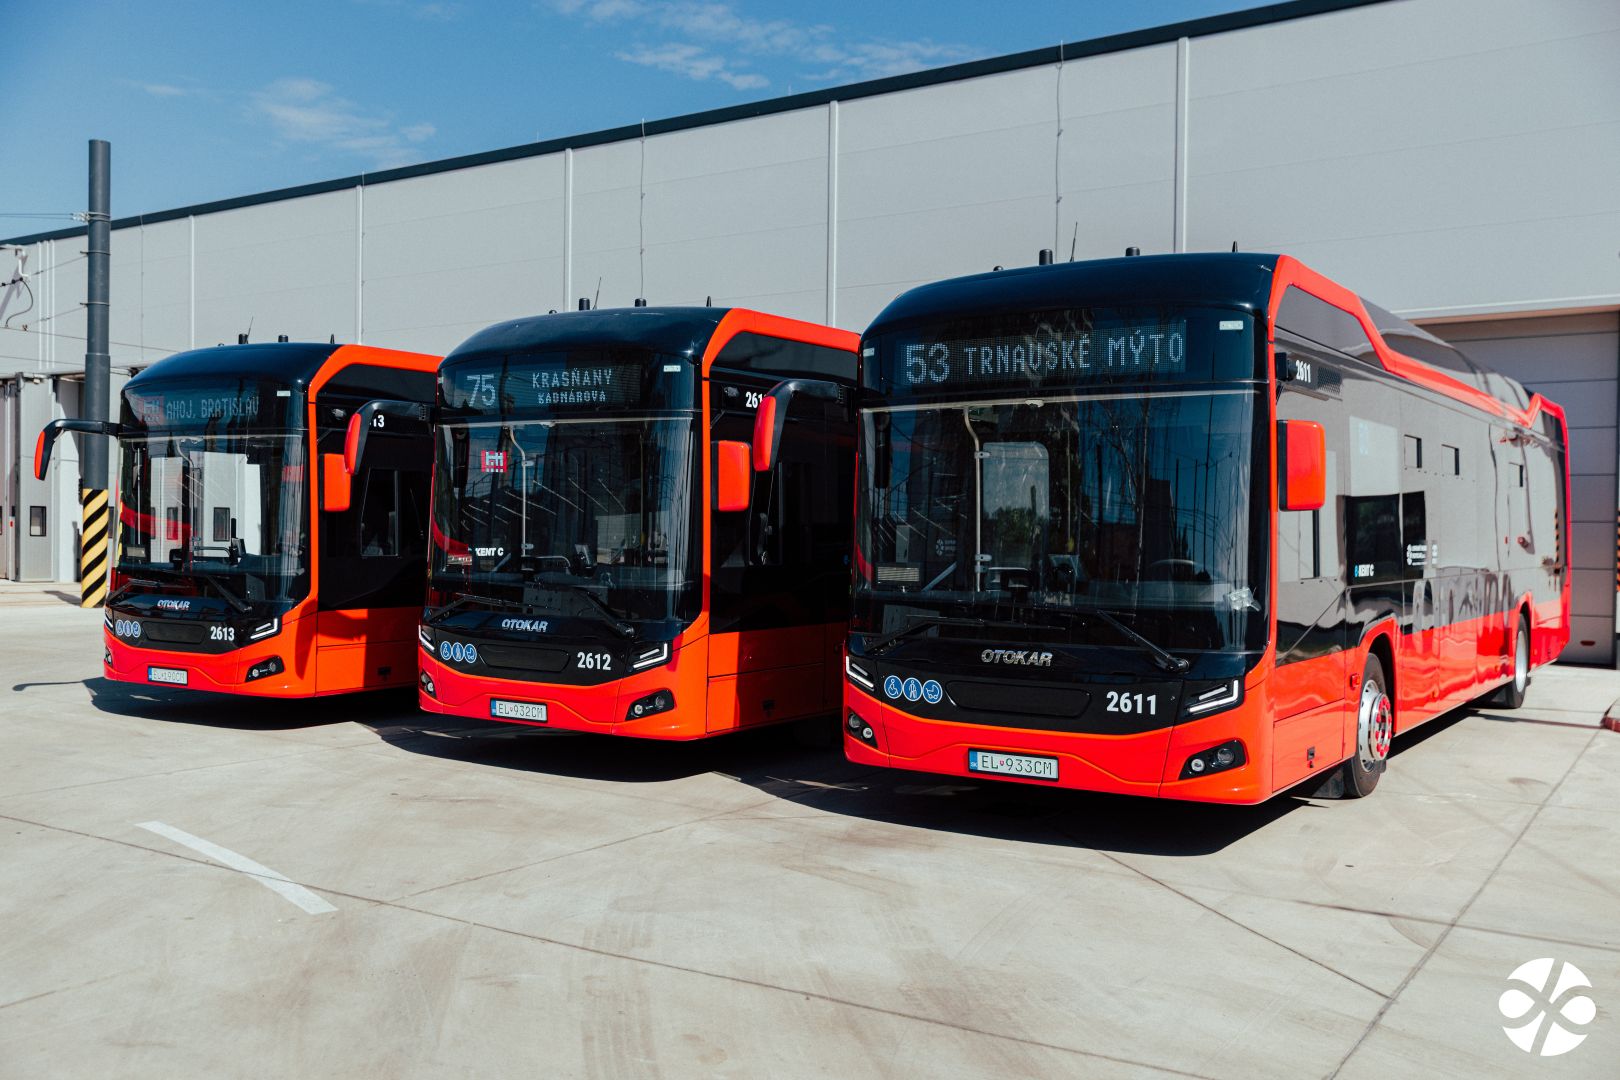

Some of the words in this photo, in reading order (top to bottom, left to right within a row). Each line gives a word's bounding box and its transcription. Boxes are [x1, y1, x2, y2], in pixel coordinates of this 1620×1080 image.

[906, 343, 950, 384] 53
[1108, 329, 1184, 367] MÝTO
[532, 367, 612, 389] KRASŇANY
[1296, 359, 1312, 383] 2611
[466, 374, 496, 407] 75
[745, 391, 767, 409] 261
[157, 599, 191, 611] OTOKAR
[210, 626, 235, 641] 2613
[501, 618, 549, 633] OTOKAR
[577, 651, 612, 671] 2612
[981, 649, 1053, 666] OTOKAR
[1106, 690, 1157, 716] 2611
